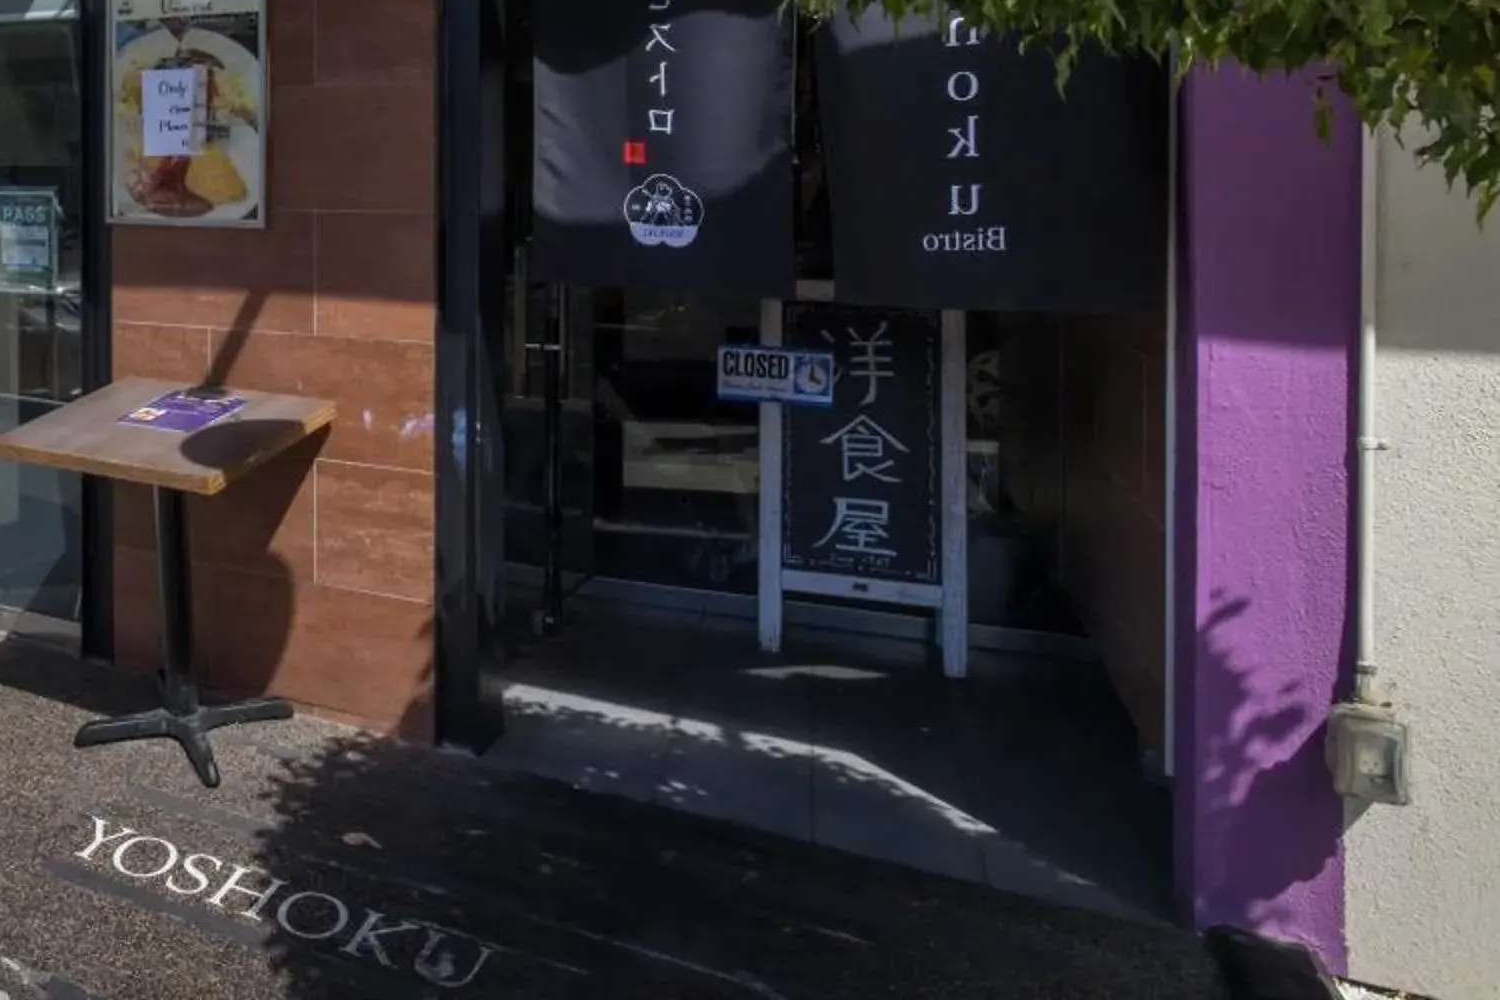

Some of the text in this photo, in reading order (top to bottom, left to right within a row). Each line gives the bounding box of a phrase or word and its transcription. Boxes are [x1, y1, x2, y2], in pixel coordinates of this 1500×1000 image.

[2, 205, 46, 222] PASS
[723, 350, 790, 379] CLOSED
[812, 321, 911, 557] 洋食屋
[74, 815, 493, 988] YOSHOKU
